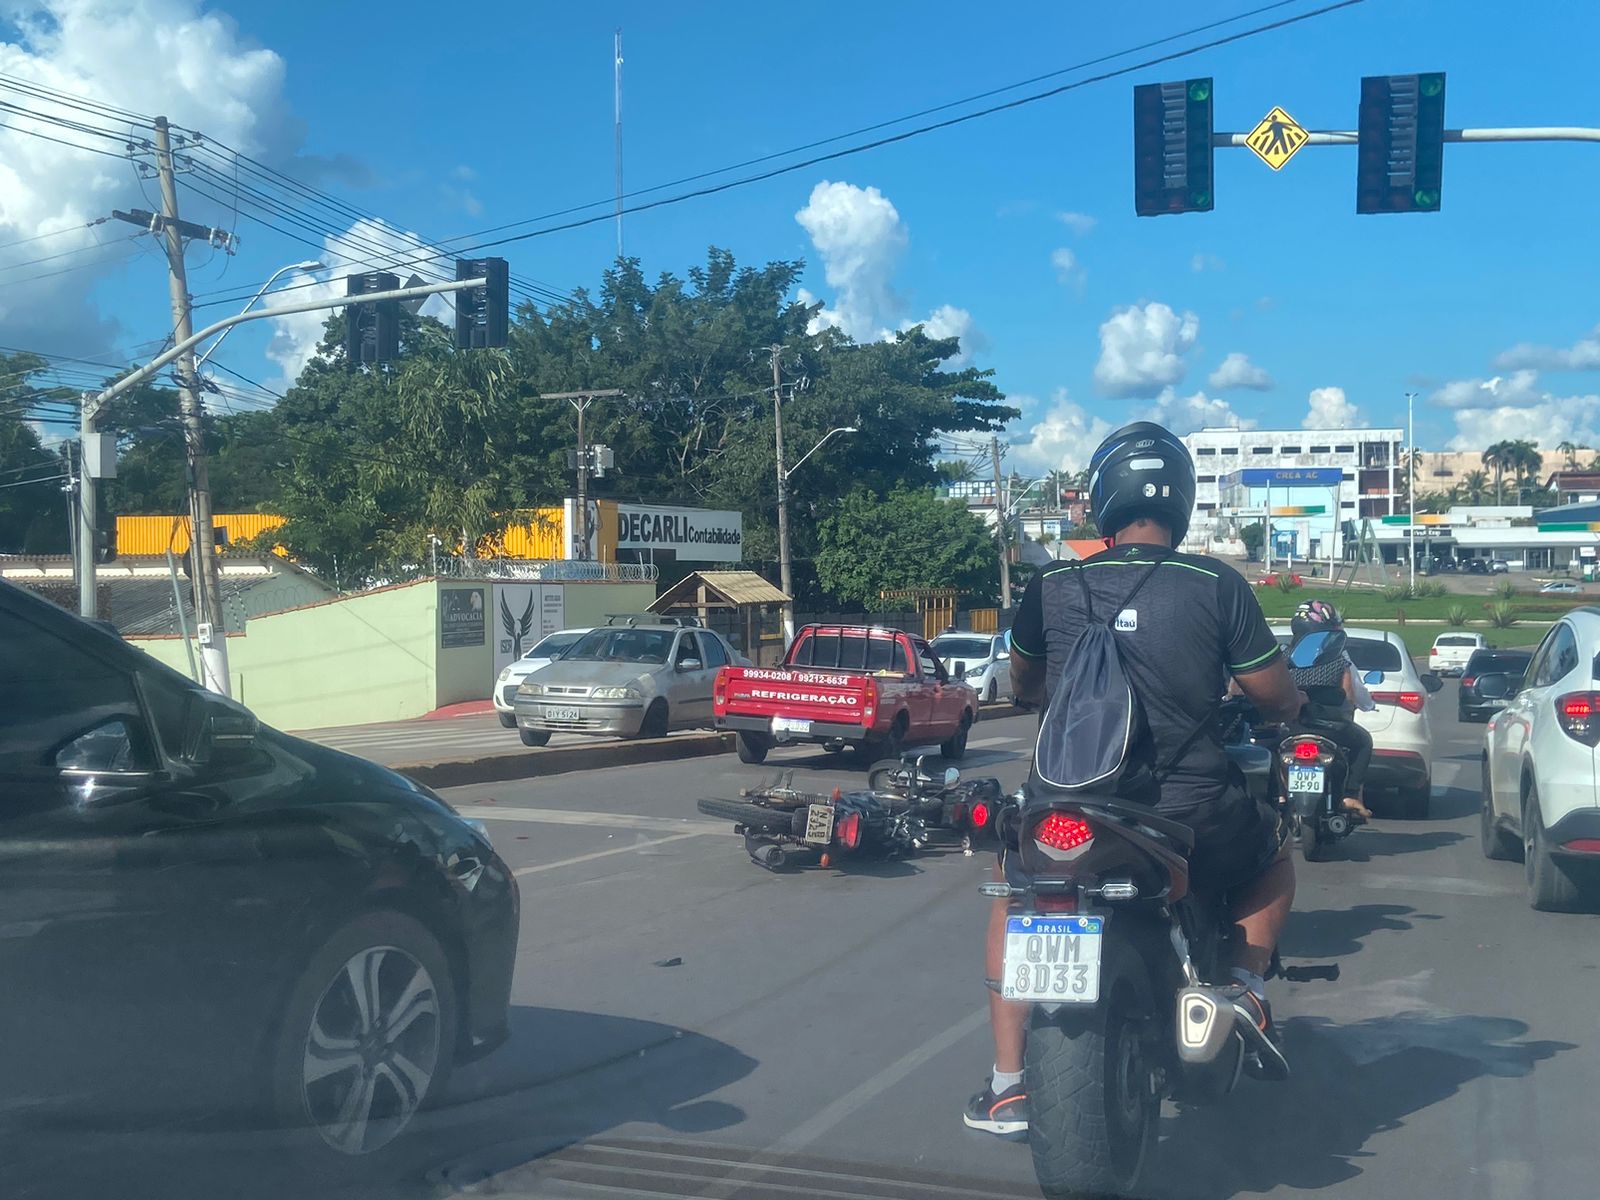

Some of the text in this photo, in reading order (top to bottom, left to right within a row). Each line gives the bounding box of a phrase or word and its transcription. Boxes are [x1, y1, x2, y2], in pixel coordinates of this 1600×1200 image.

[618, 513, 741, 545] DECARLI Contabilidade
[743, 669, 791, 681] 99934-0208
[751, 690, 857, 705] REFRIGERAÇÃO
[1037, 925, 1072, 933] BRASIL
[1026, 935, 1080, 963] QWM
[1015, 964, 1088, 993] 8D33
